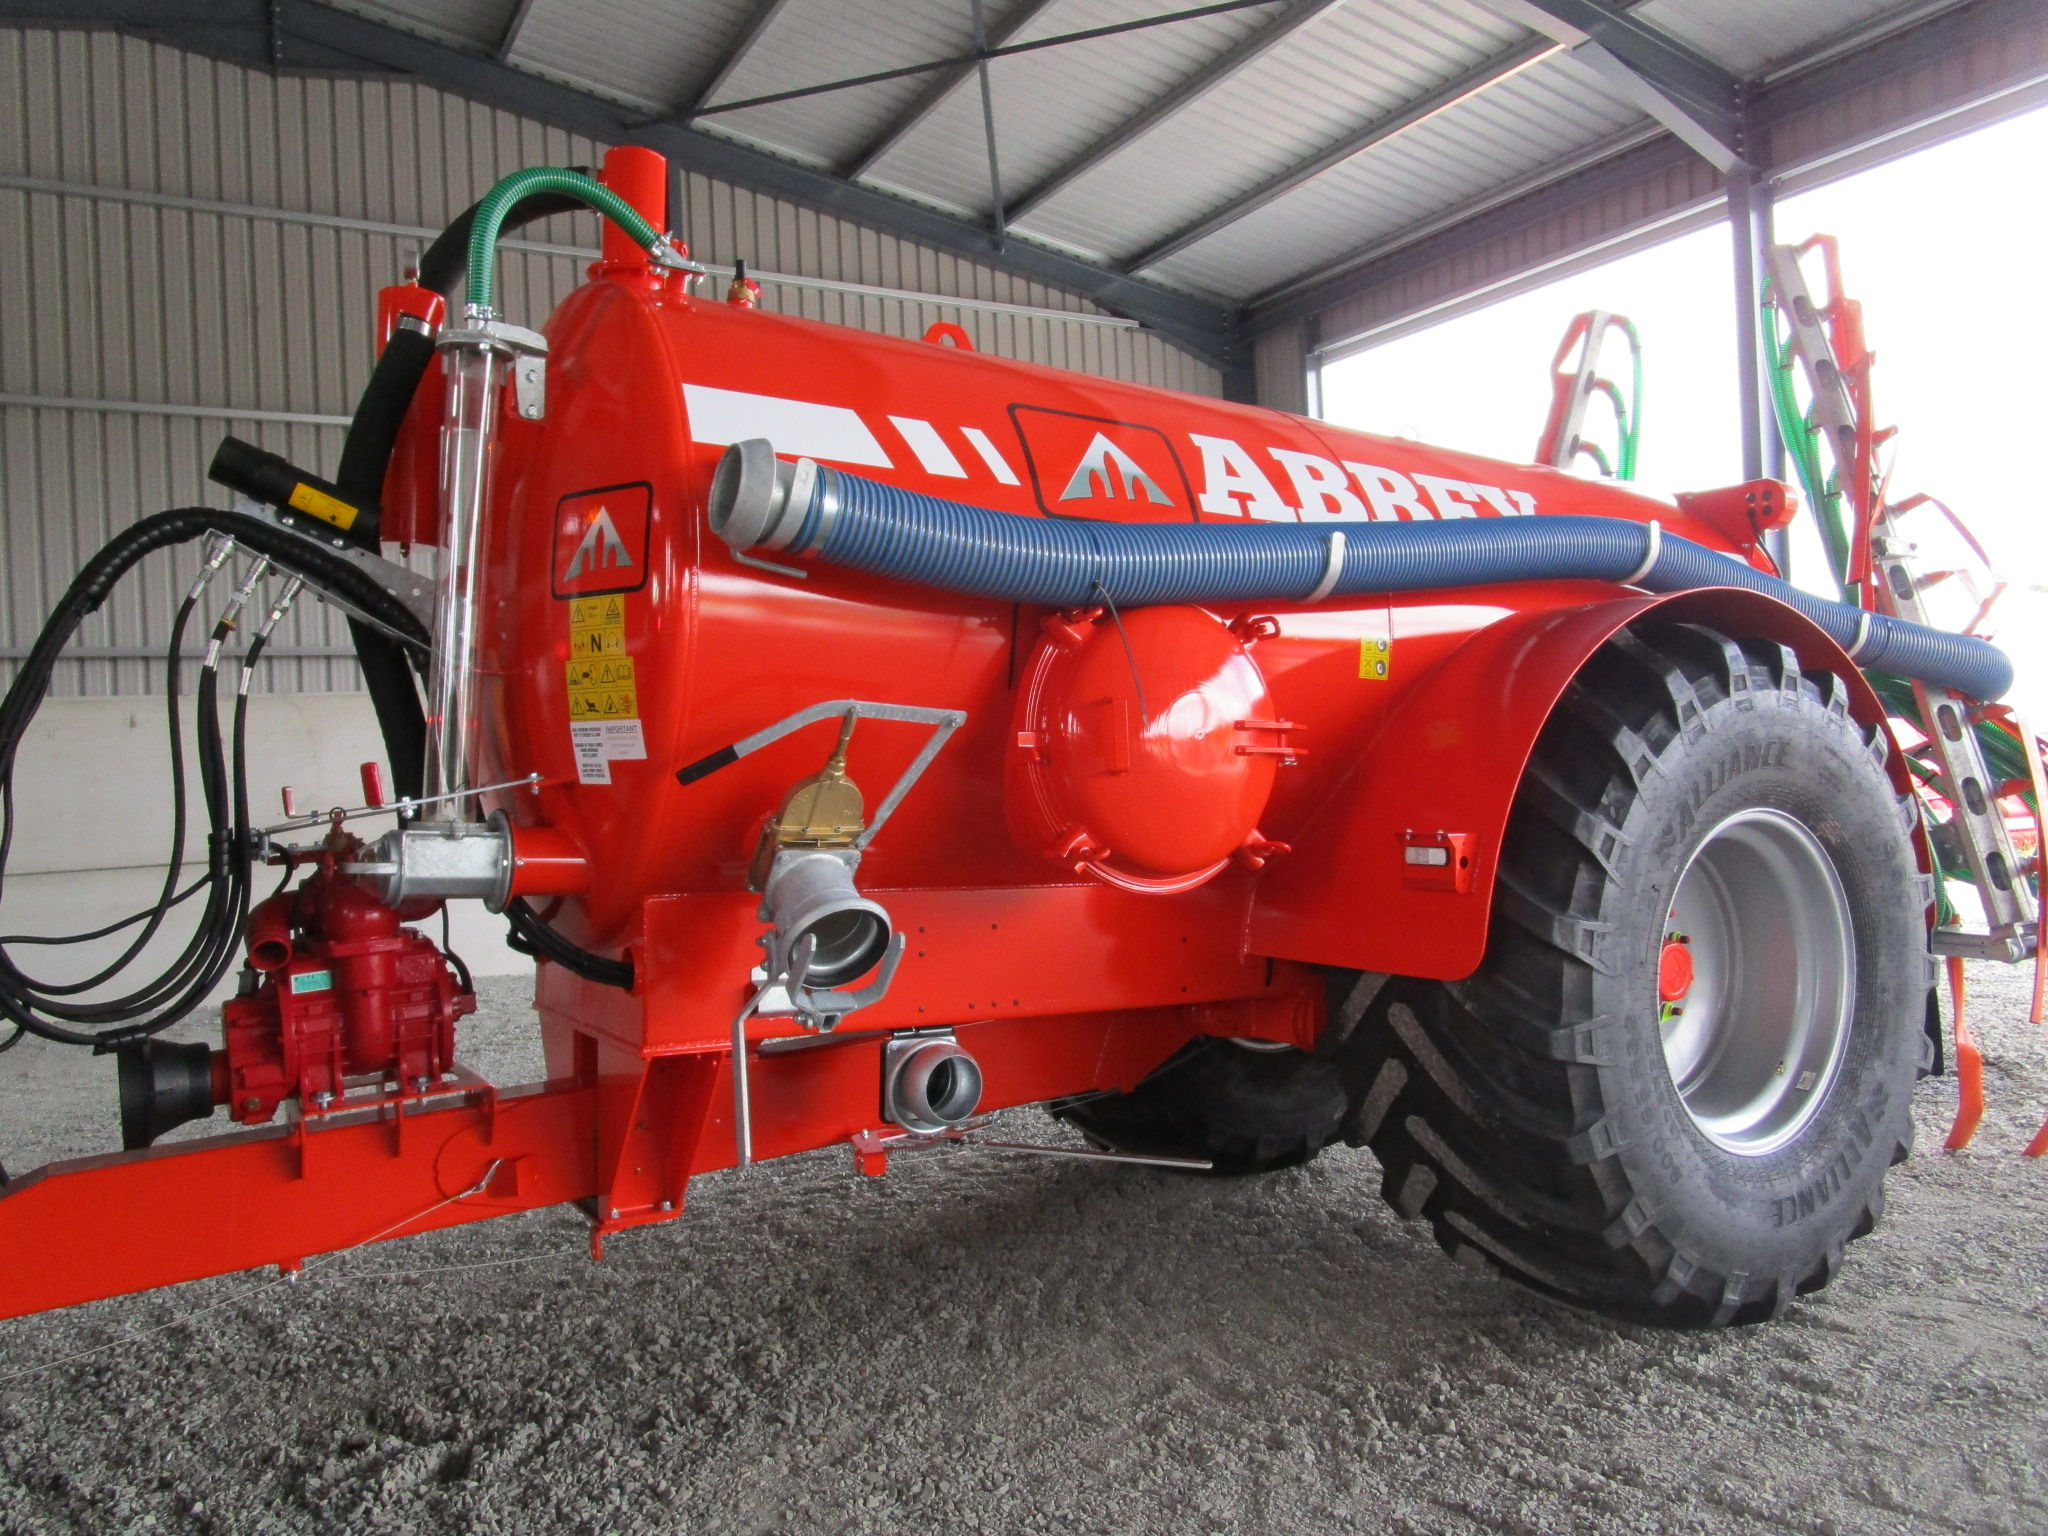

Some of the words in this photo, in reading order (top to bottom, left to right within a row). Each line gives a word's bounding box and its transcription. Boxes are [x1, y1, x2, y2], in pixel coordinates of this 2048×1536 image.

[591, 632, 603, 653] N
[606, 725, 638, 735] IMPORTANT
[1676, 739, 1791, 841] ALLIANCE
[1768, 1110, 1873, 1228] ALLIANCE
